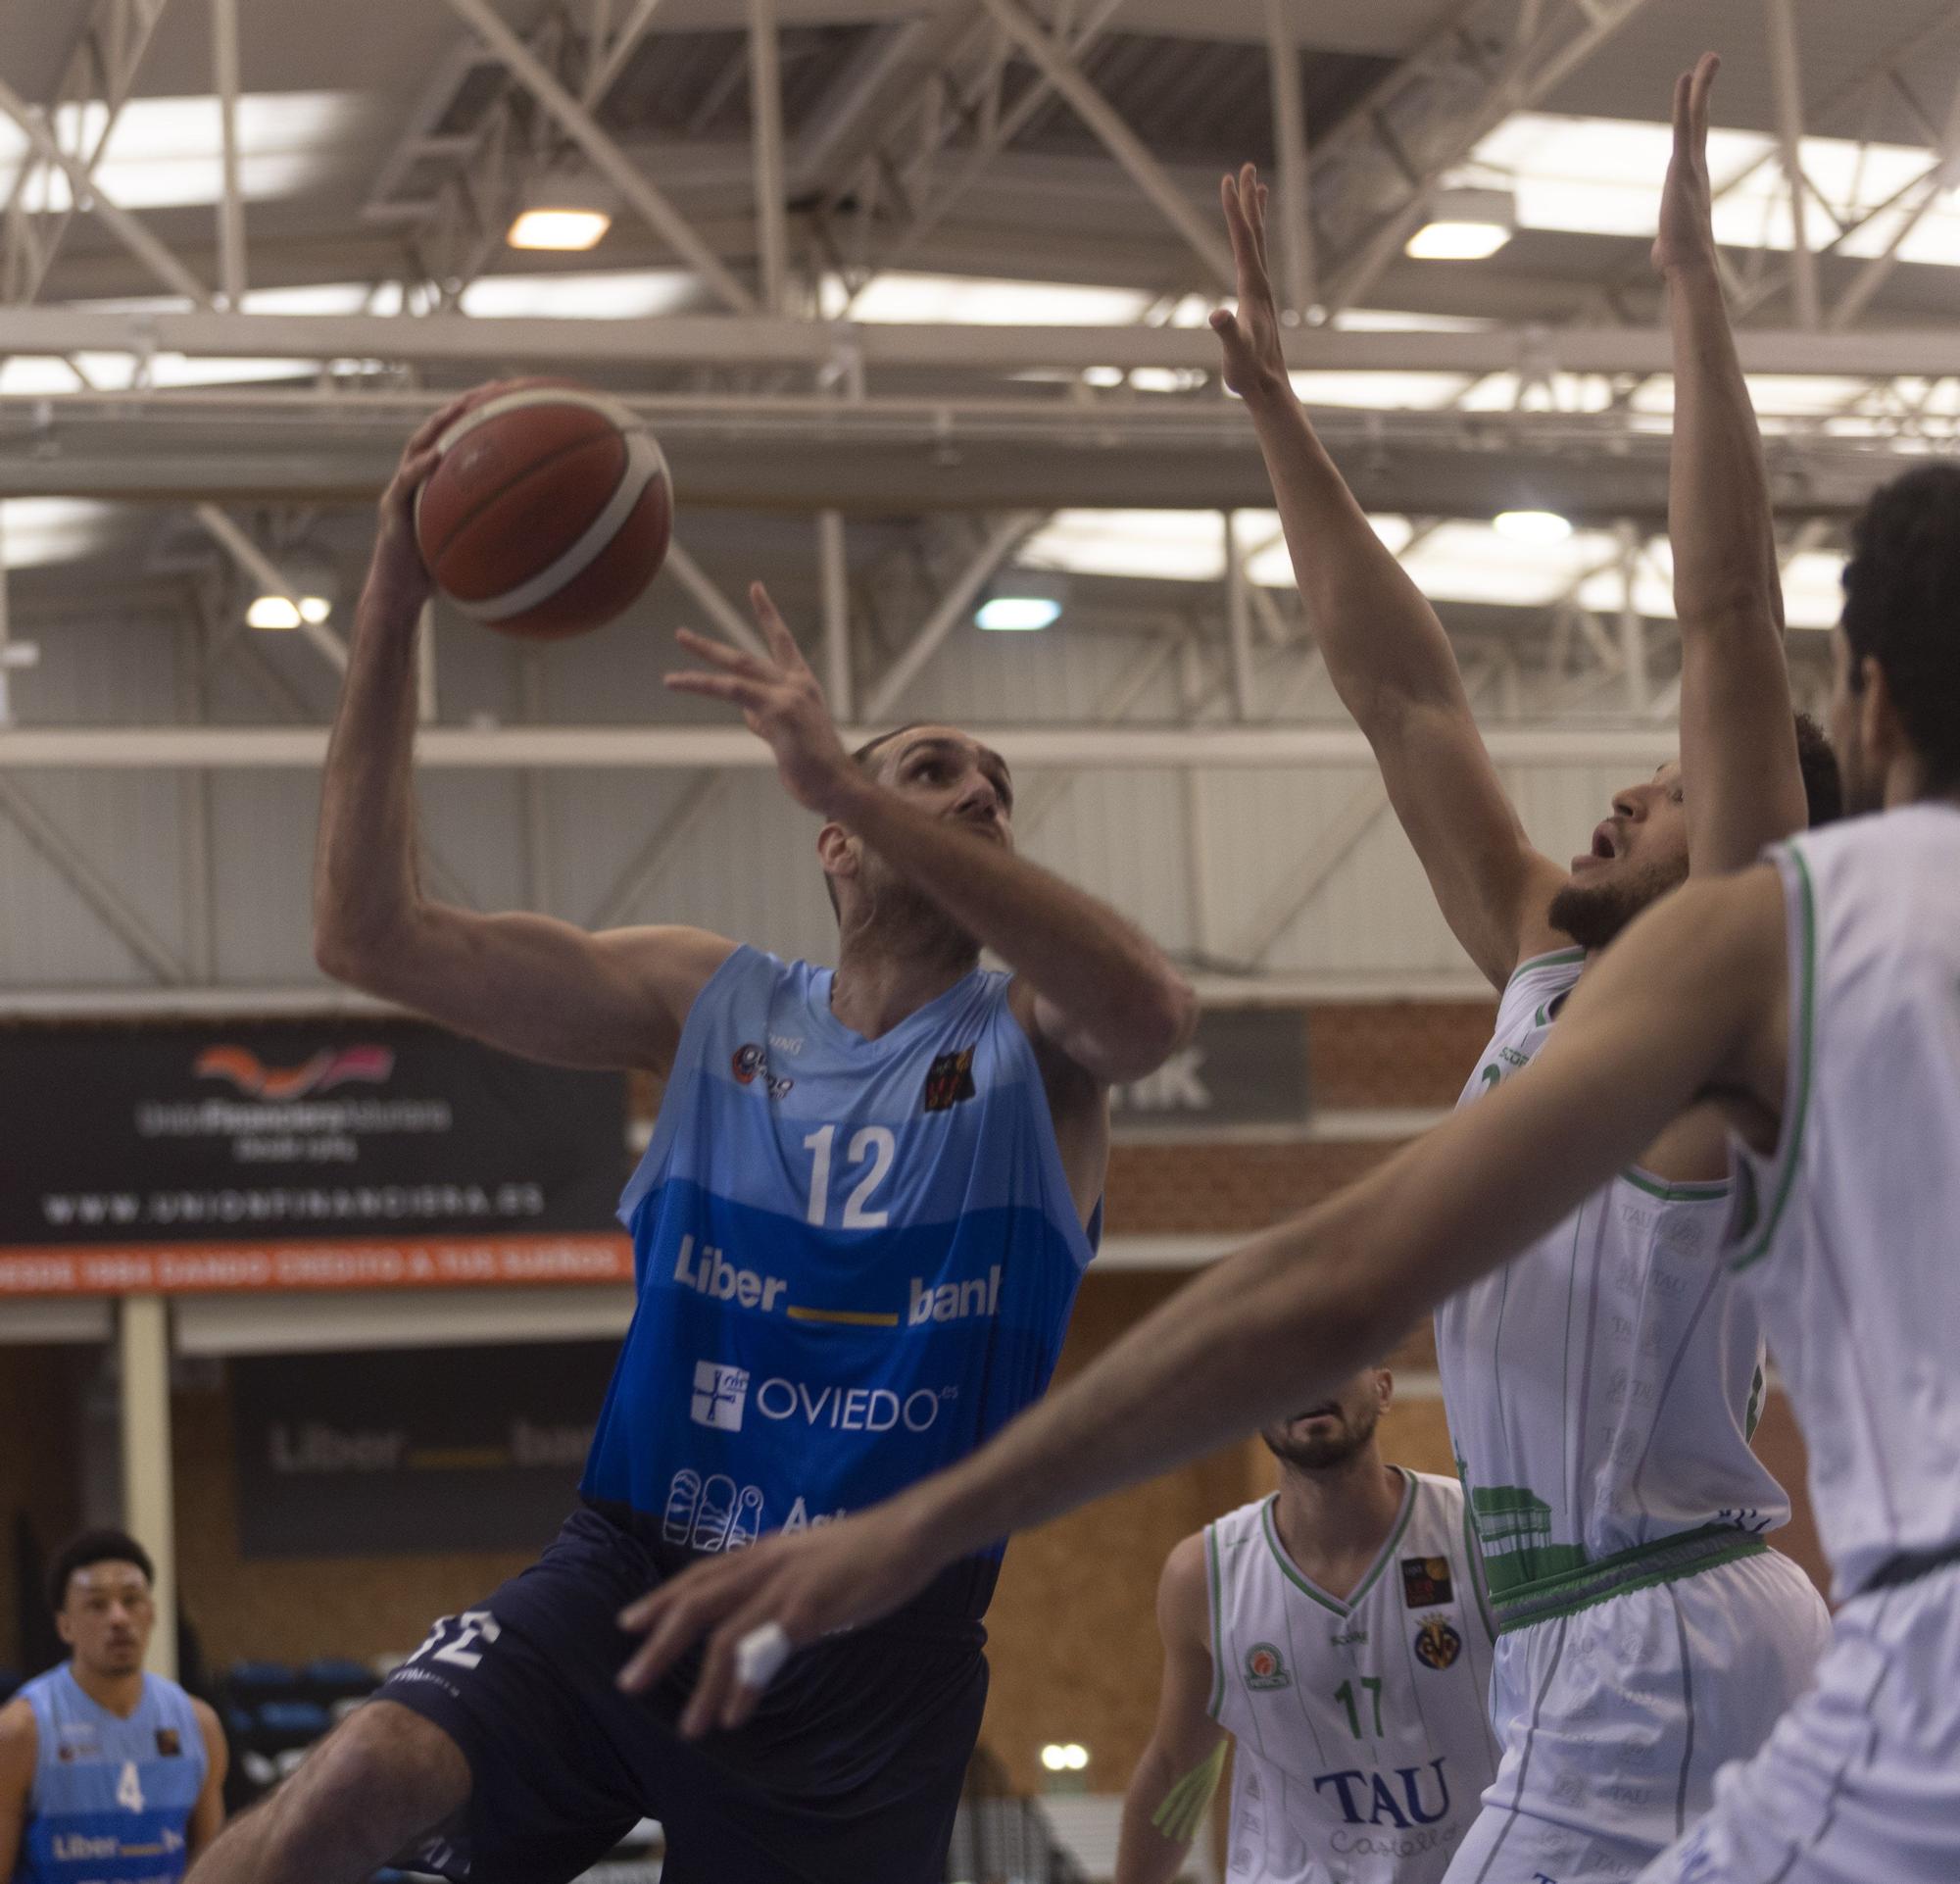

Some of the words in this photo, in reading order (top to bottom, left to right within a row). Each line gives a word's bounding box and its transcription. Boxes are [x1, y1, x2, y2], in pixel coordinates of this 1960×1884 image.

[44, 1184, 545, 1221] WWW.UNIONFINANCIERA.ES
[804, 1125, 896, 1229] 12
[674, 1233, 787, 1312] Liber
[757, 1377, 939, 1432] OVIEDO
[1333, 1675, 1384, 1740] 17
[116, 1761, 144, 1813] 4
[1313, 1756, 1450, 1829] TAU
